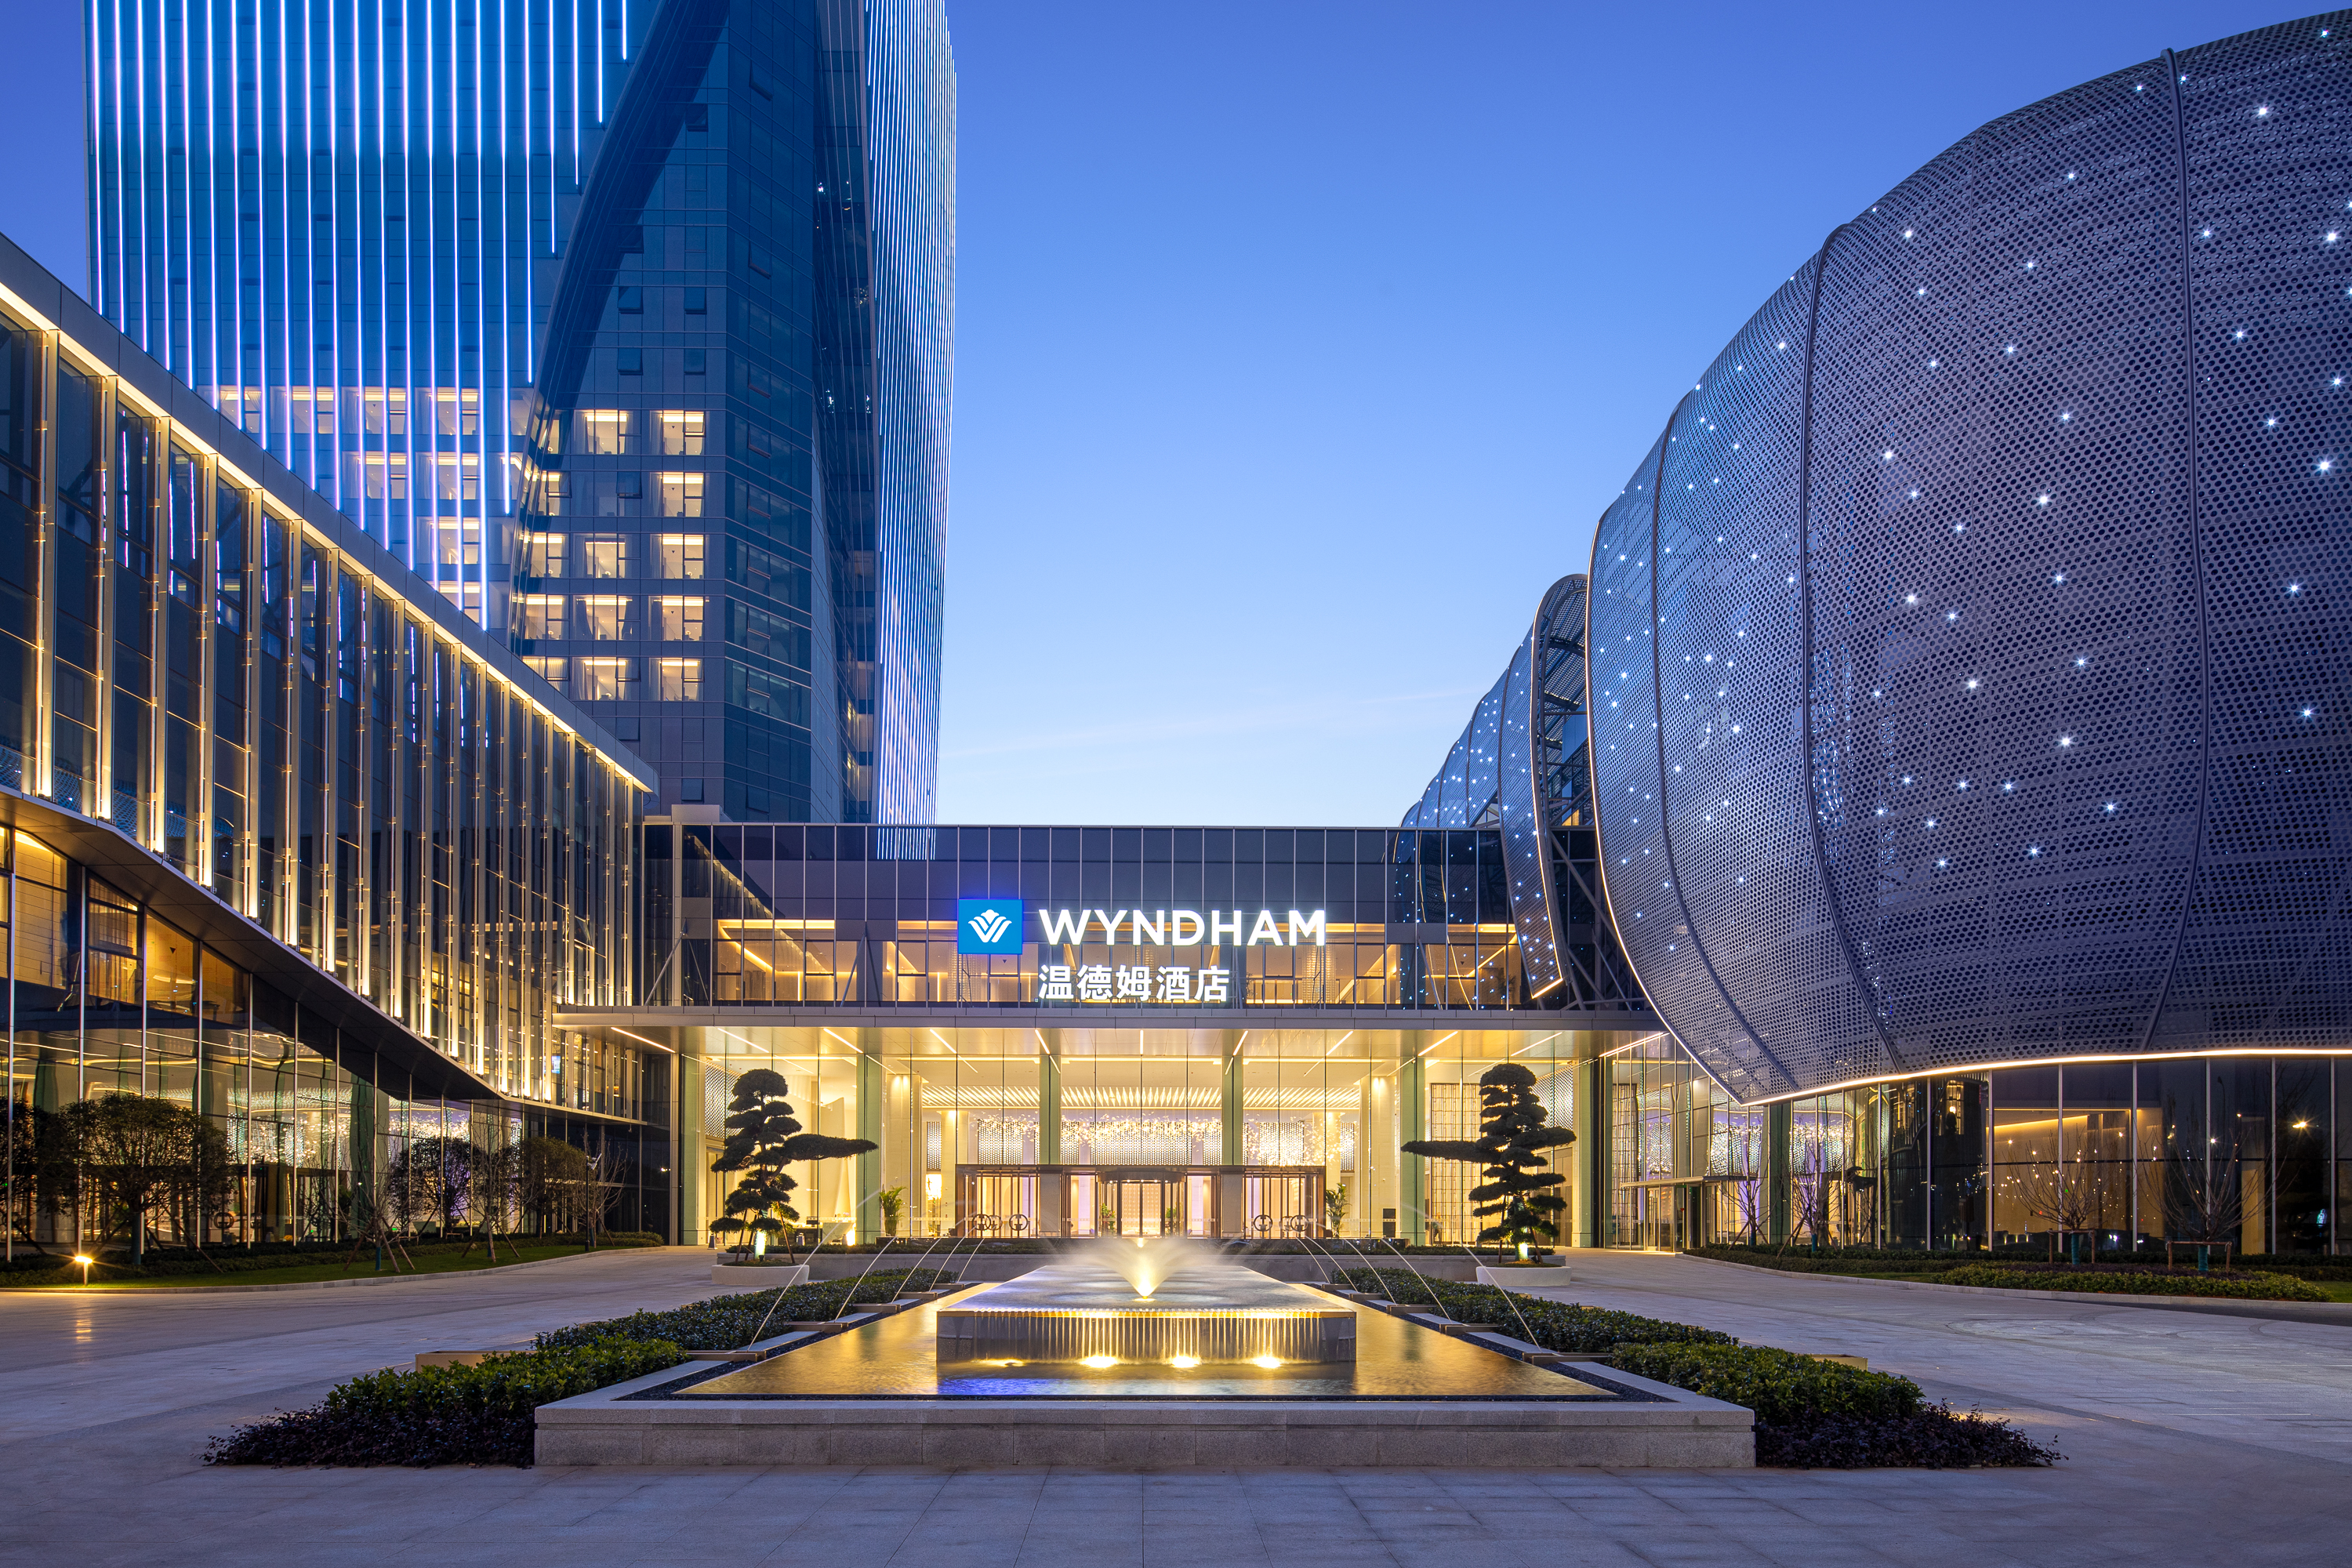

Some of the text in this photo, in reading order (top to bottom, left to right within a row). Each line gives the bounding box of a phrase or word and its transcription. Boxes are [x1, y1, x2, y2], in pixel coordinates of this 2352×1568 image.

[1038, 909, 1326, 946] WYNDHAM
[1038, 964, 1230, 1002] 温德姆酒店
